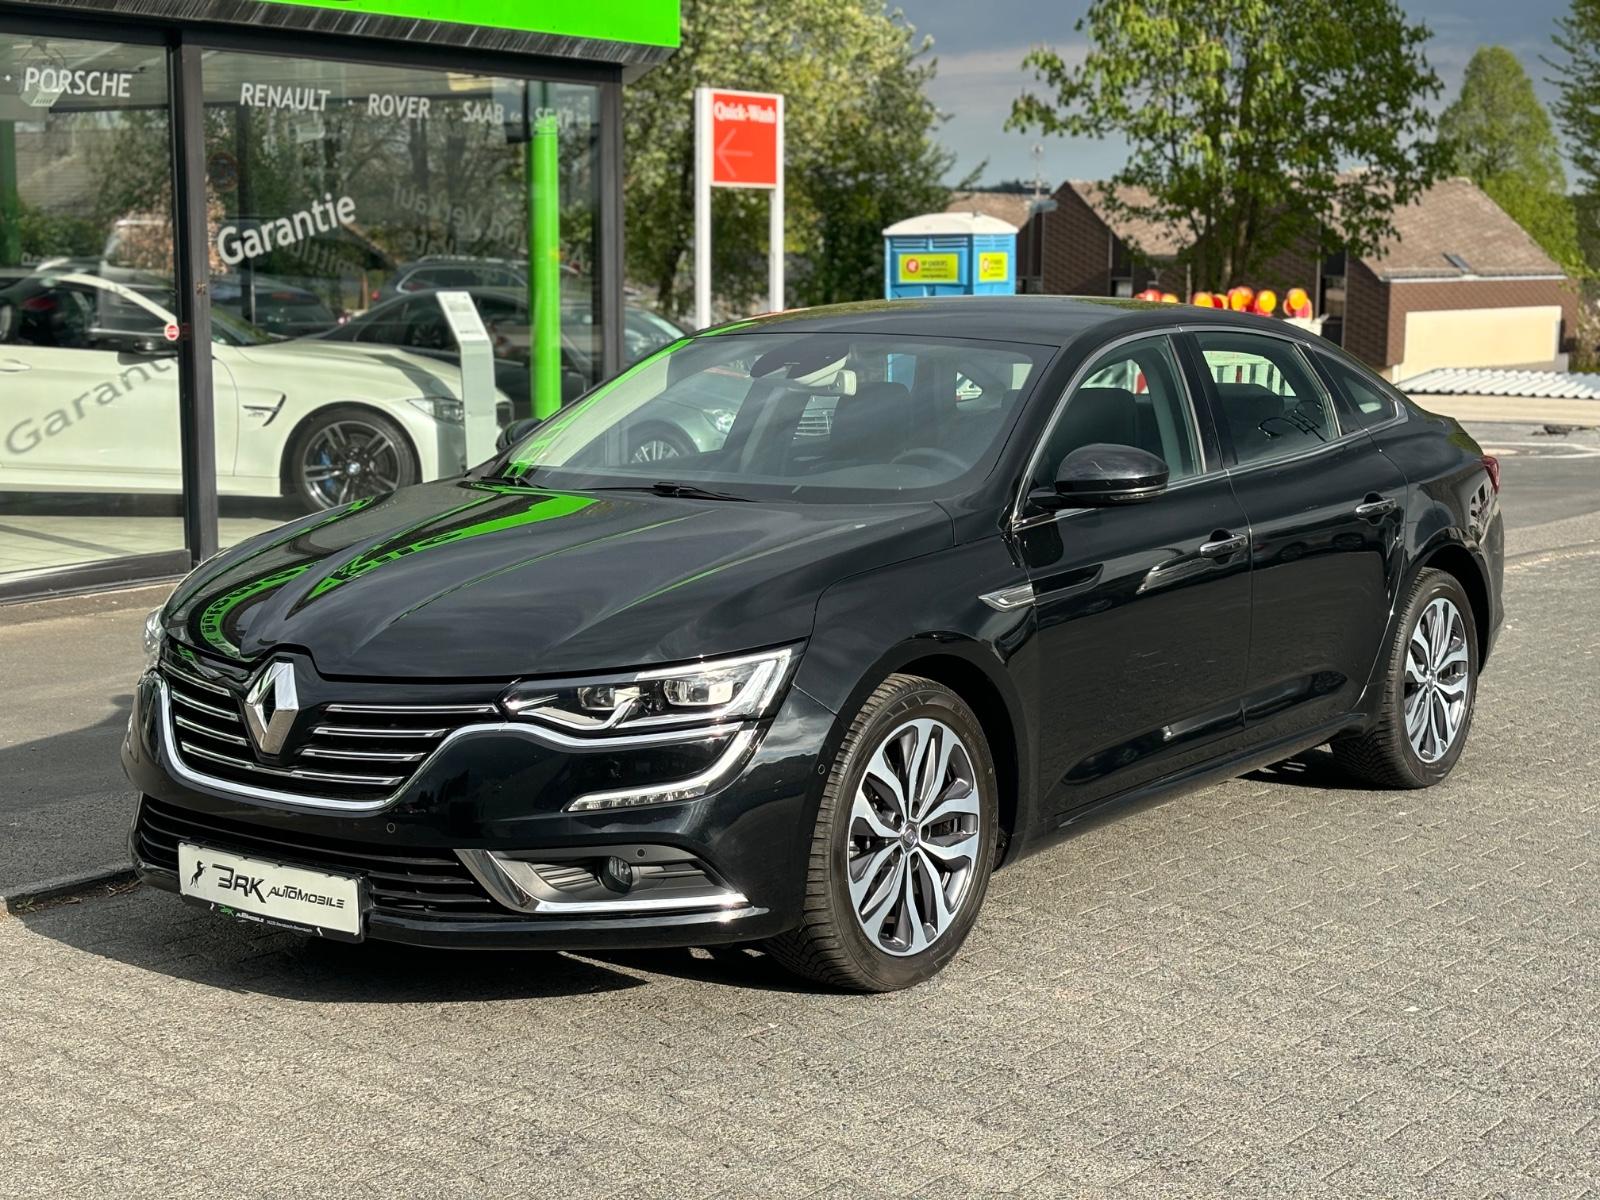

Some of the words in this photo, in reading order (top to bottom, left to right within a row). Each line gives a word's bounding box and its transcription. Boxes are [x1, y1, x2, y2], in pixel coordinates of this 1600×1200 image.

[24, 67, 133, 98] PORSCHE
[239, 82, 331, 112] RENAULT
[367, 93, 430, 119] ROVER
[462, 101, 505, 125] SAAB
[217, 192, 357, 265] Garantie
[266, 885, 345, 909] AUTOMOBILE
